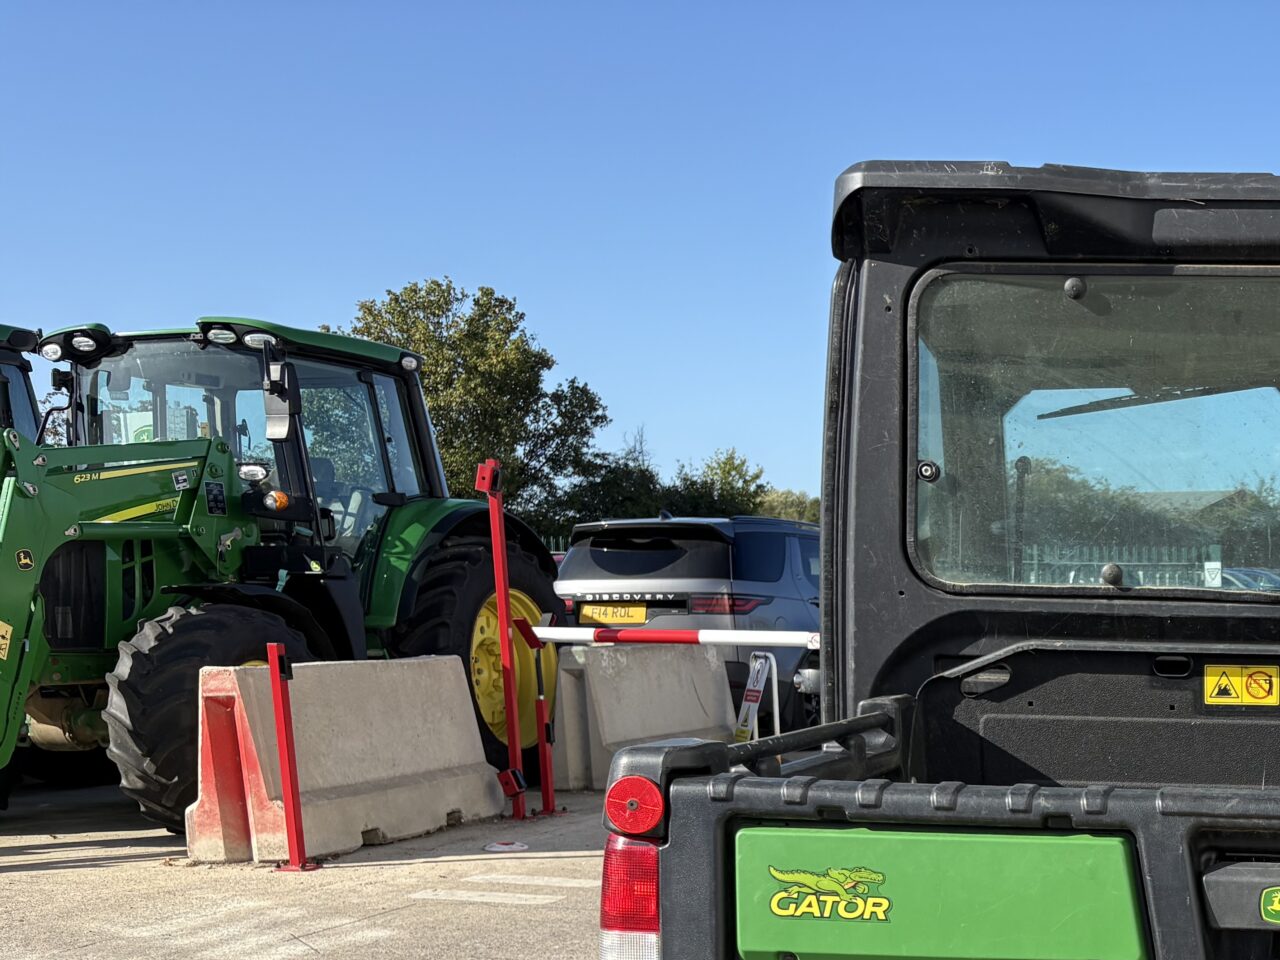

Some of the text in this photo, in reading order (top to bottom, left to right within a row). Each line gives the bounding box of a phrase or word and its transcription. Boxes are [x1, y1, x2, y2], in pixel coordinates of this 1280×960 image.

[73, 473, 99, 484] 623 M
[154, 502, 172, 512] JOHN
[585, 593, 675, 601] DISCOVERY
[769, 890, 890, 920] GATOR
